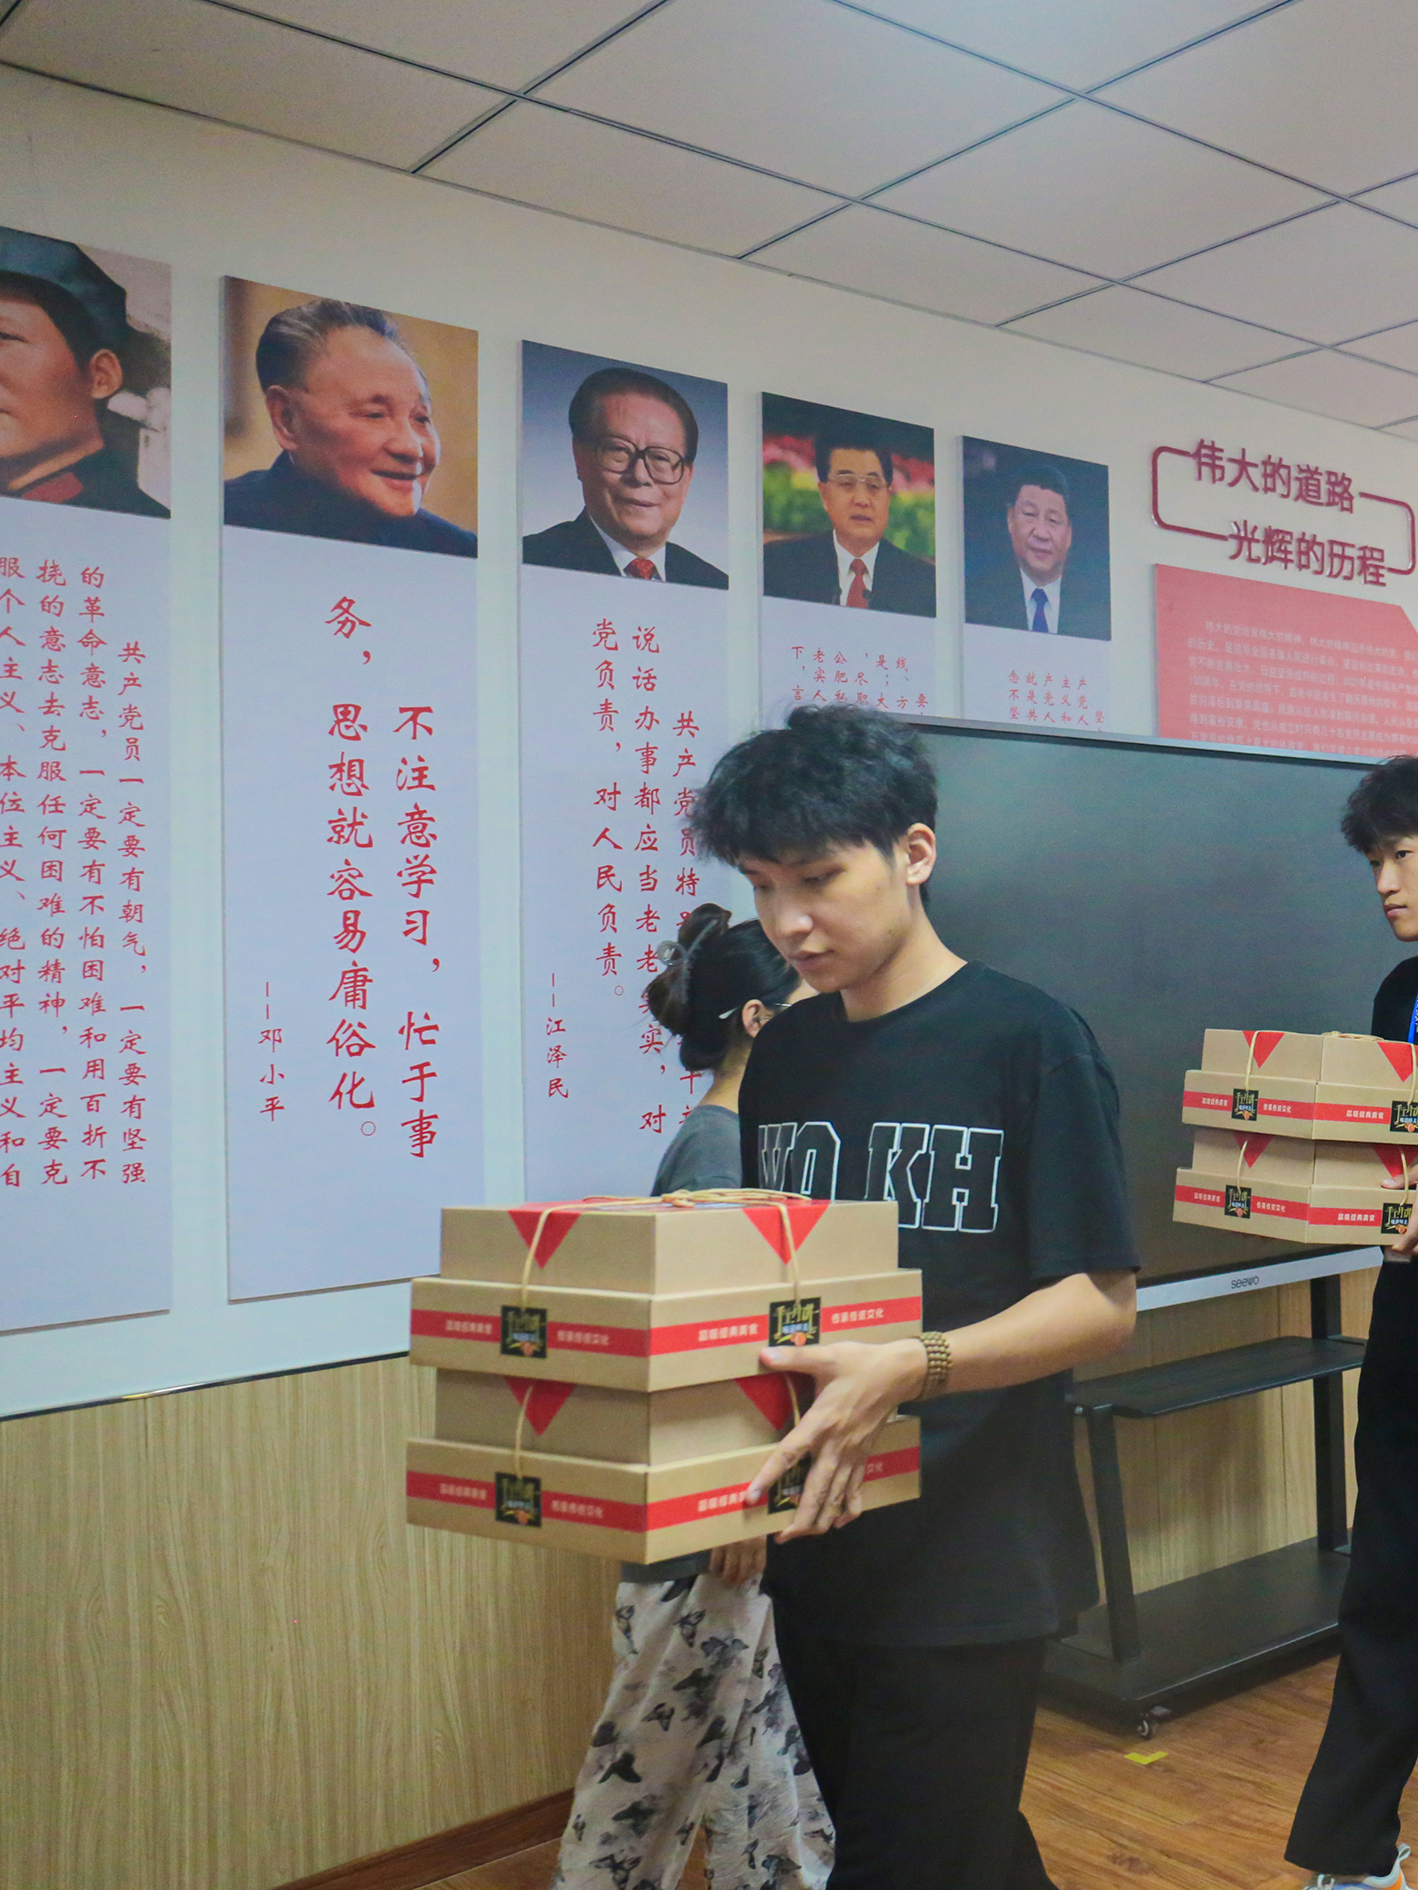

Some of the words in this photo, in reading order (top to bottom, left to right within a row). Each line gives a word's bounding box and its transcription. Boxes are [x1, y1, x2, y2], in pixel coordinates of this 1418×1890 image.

[1190, 438, 1355, 514] 伟大的道路
[1228, 519, 1387, 587] 光辉的历程
[791, 646, 806, 709] 下，言
[812, 648, 827, 702] 老实人
[1061, 676, 1072, 723] 主义和
[592, 617, 624, 997] 党负责，对人民负责。
[36, 559, 68, 1186] 挠的意志去克服任何困难的精神，一定要克
[77, 566, 107, 1180] 的革命意志，一定要有不怕困难和用百折不
[117, 641, 147, 1184] 共产党员一定要有朝气，一定要有坚强
[393, 705, 440, 1159] 不注意学习，忙于事
[1231, 1276, 1259, 1289] seewo
